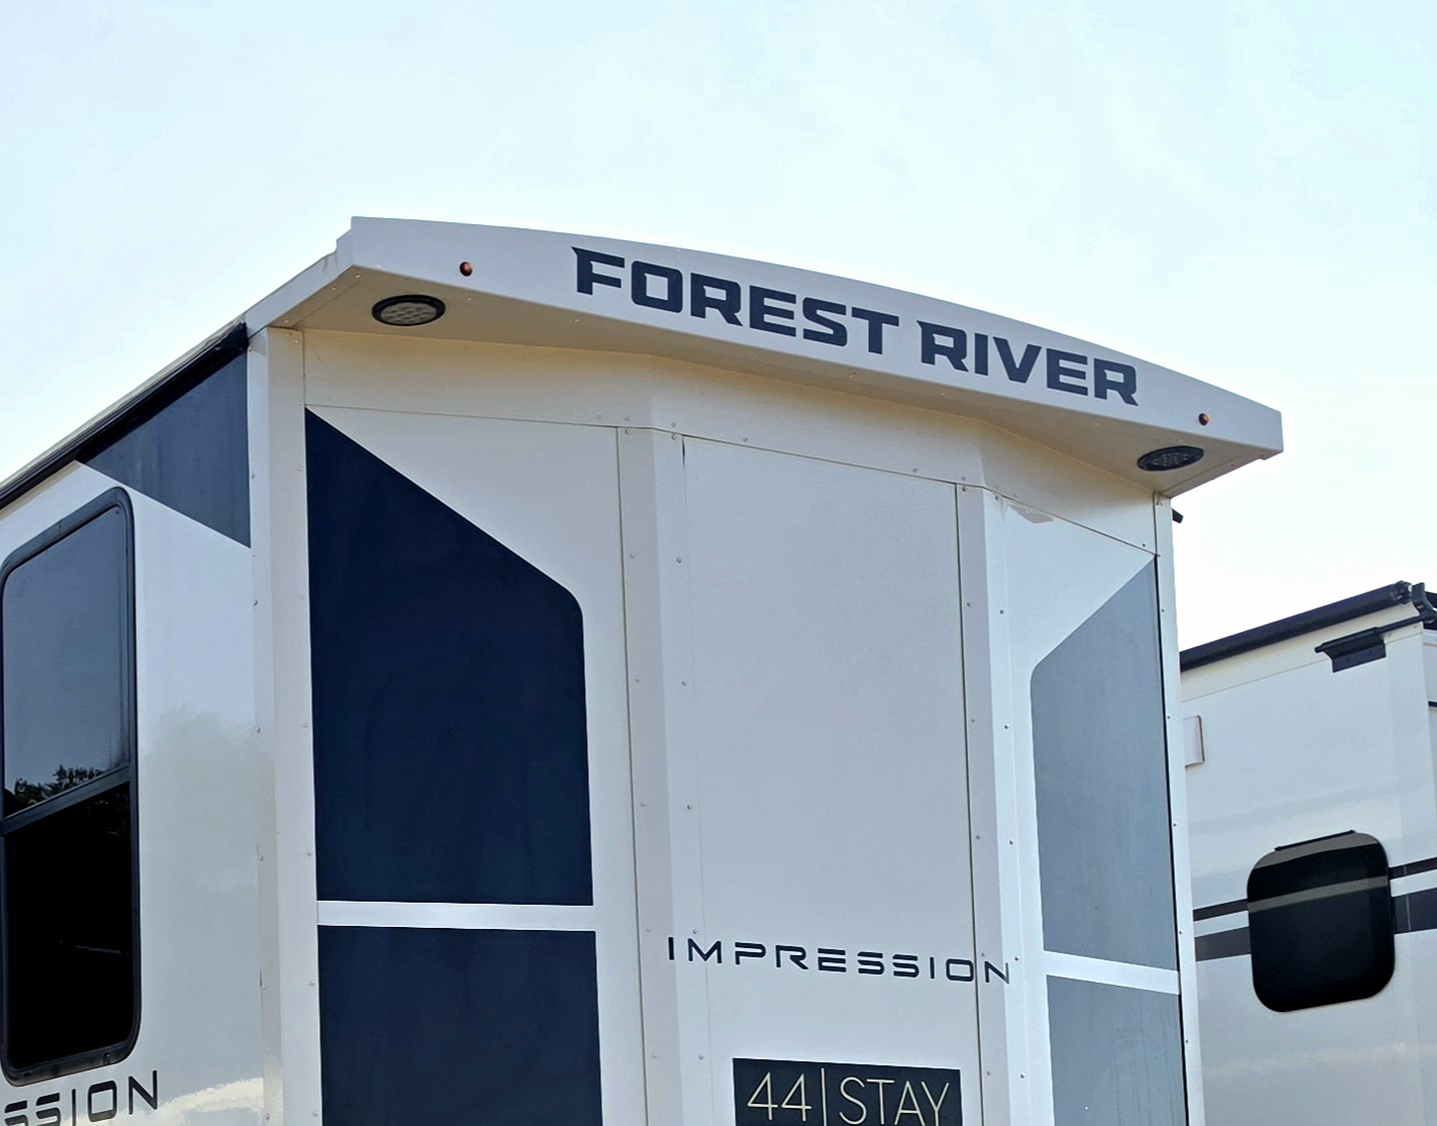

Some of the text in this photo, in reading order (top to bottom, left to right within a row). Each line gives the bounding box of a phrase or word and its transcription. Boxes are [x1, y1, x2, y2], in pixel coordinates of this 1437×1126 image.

[569, 246, 1139, 407] FOREST RIVER
[667, 936, 1010, 985] IMPRESSION
